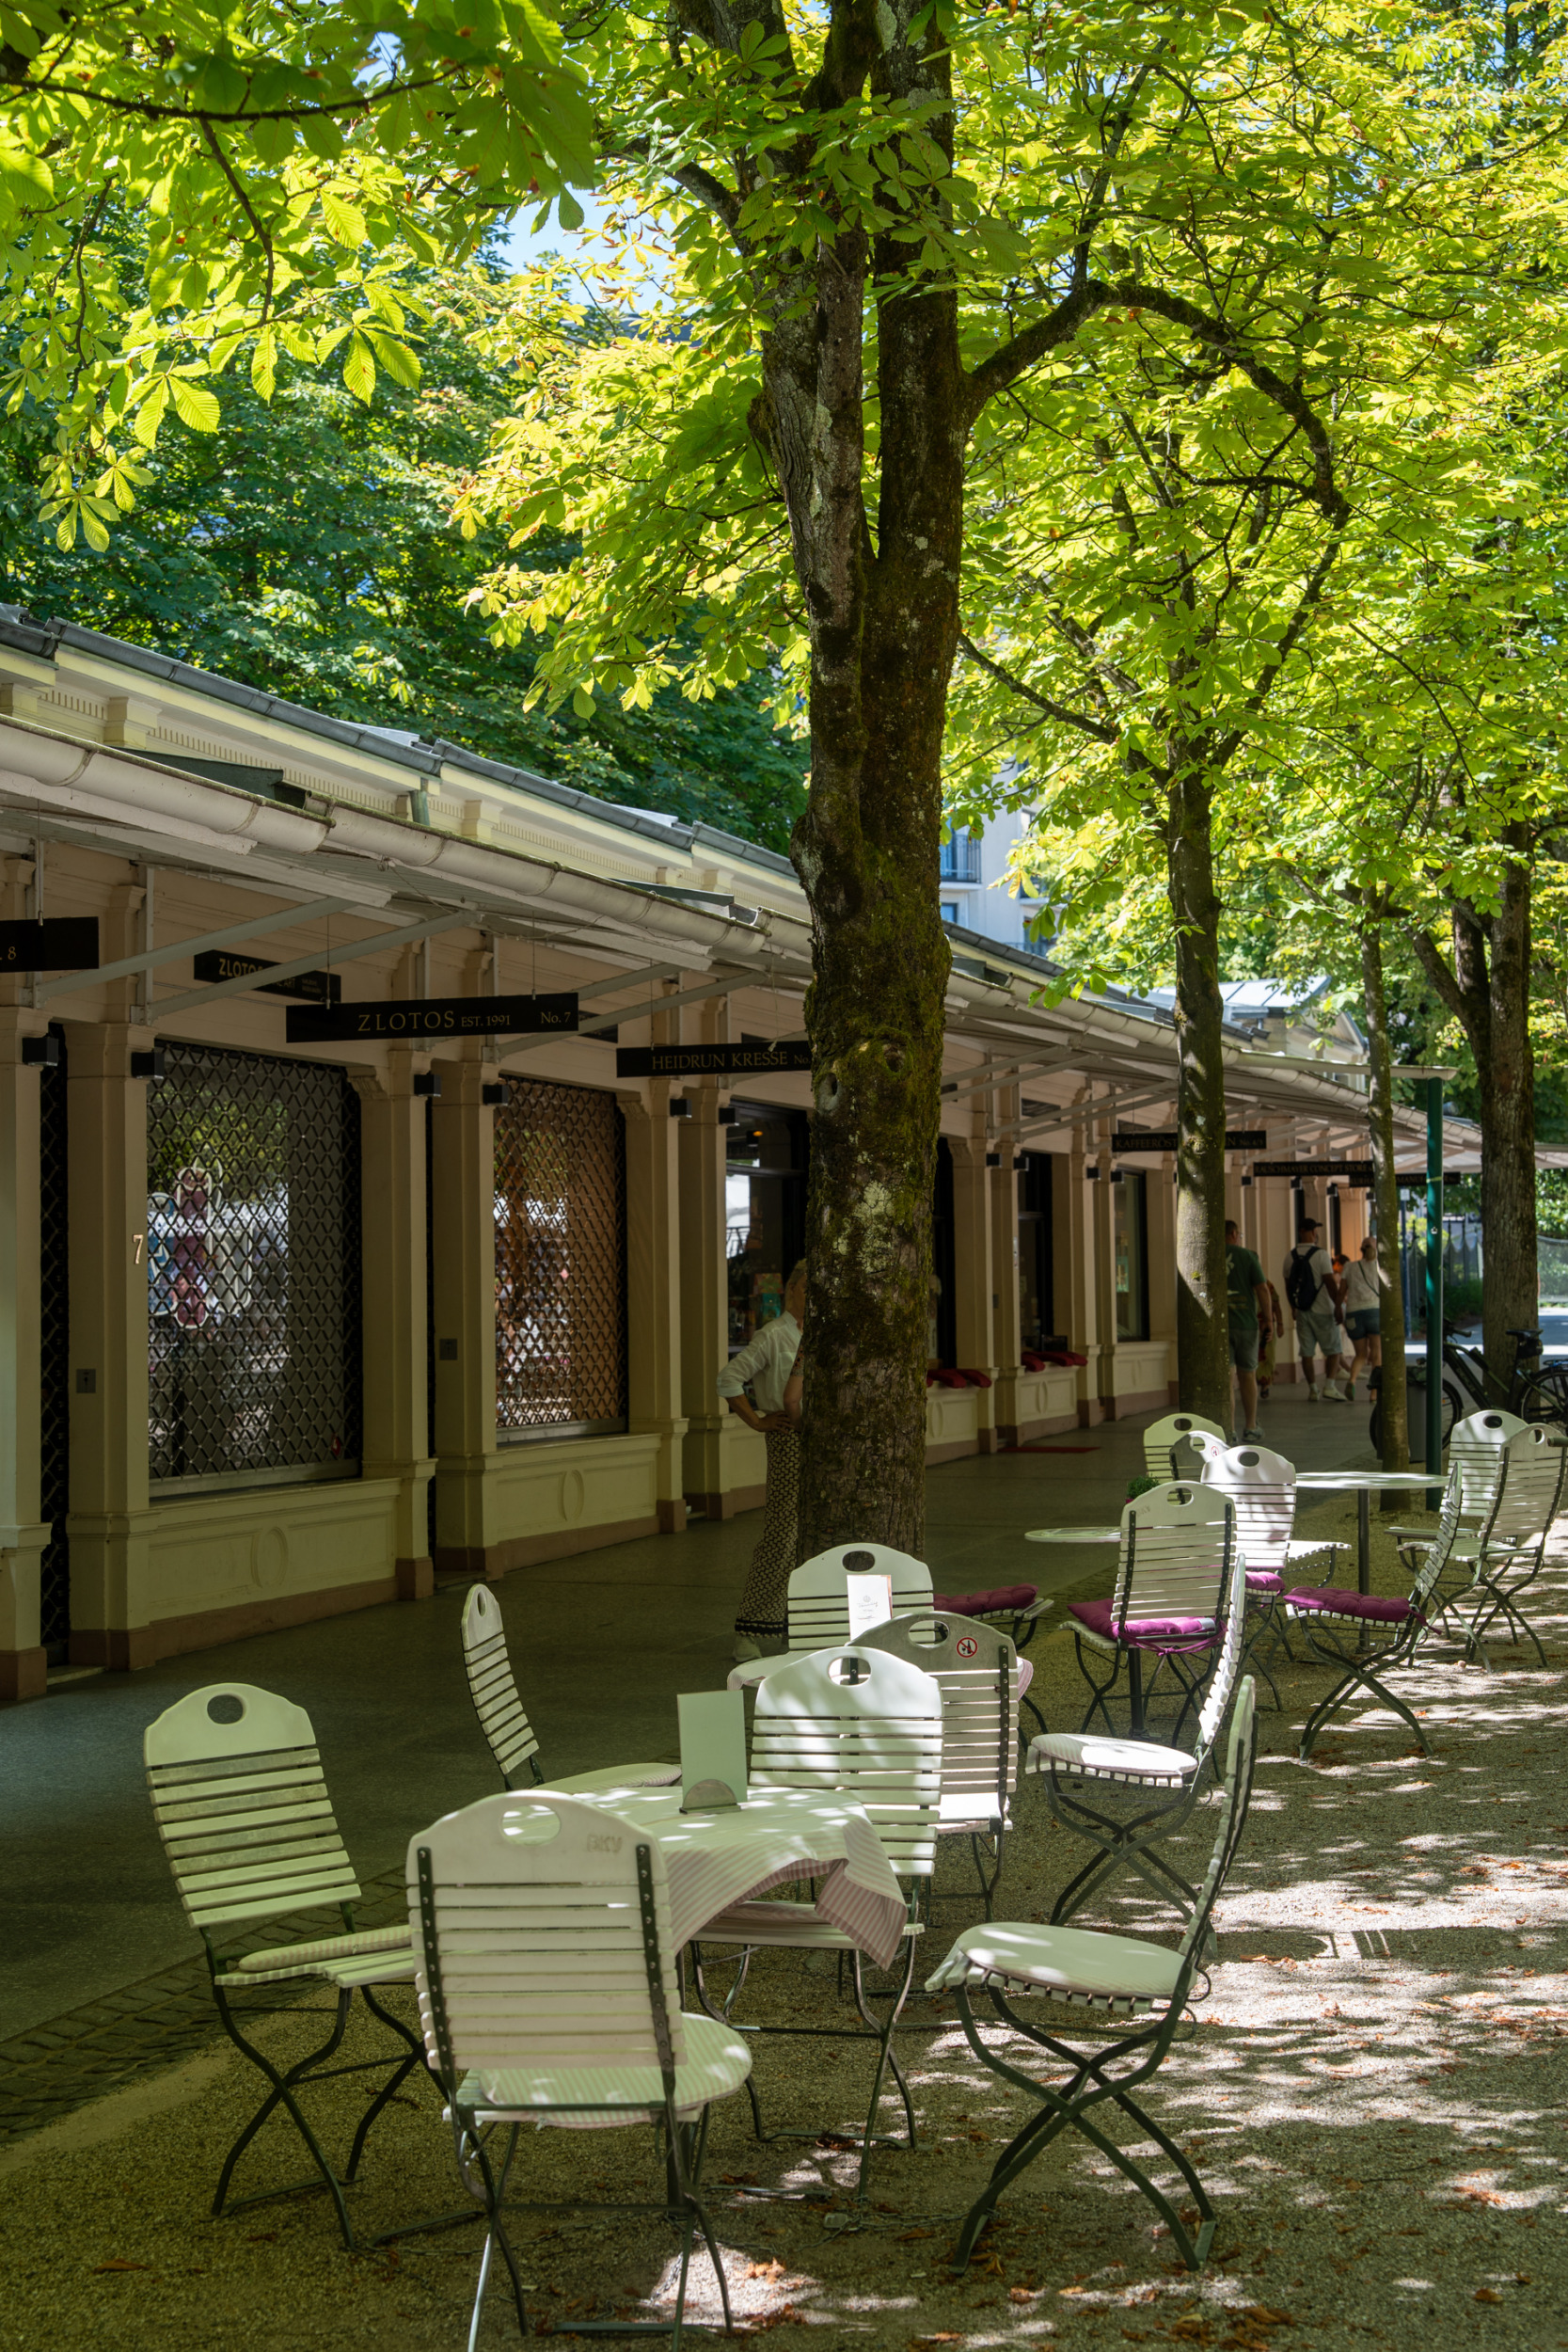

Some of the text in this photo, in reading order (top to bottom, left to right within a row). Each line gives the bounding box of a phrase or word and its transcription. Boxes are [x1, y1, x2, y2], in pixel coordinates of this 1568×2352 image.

[8, 946, 18, 961] 8
[357, 1009, 455, 1032] ZLOTOS
[461, 1015, 484, 1027] EST.
[485, 1014, 511, 1026] 1991
[540, 1011, 562, 1024] No.
[563, 1011, 572, 1023] 7
[652, 1051, 811, 1070] HEIDRUN KRESSE No.
[133, 1233, 144, 1264] 7
